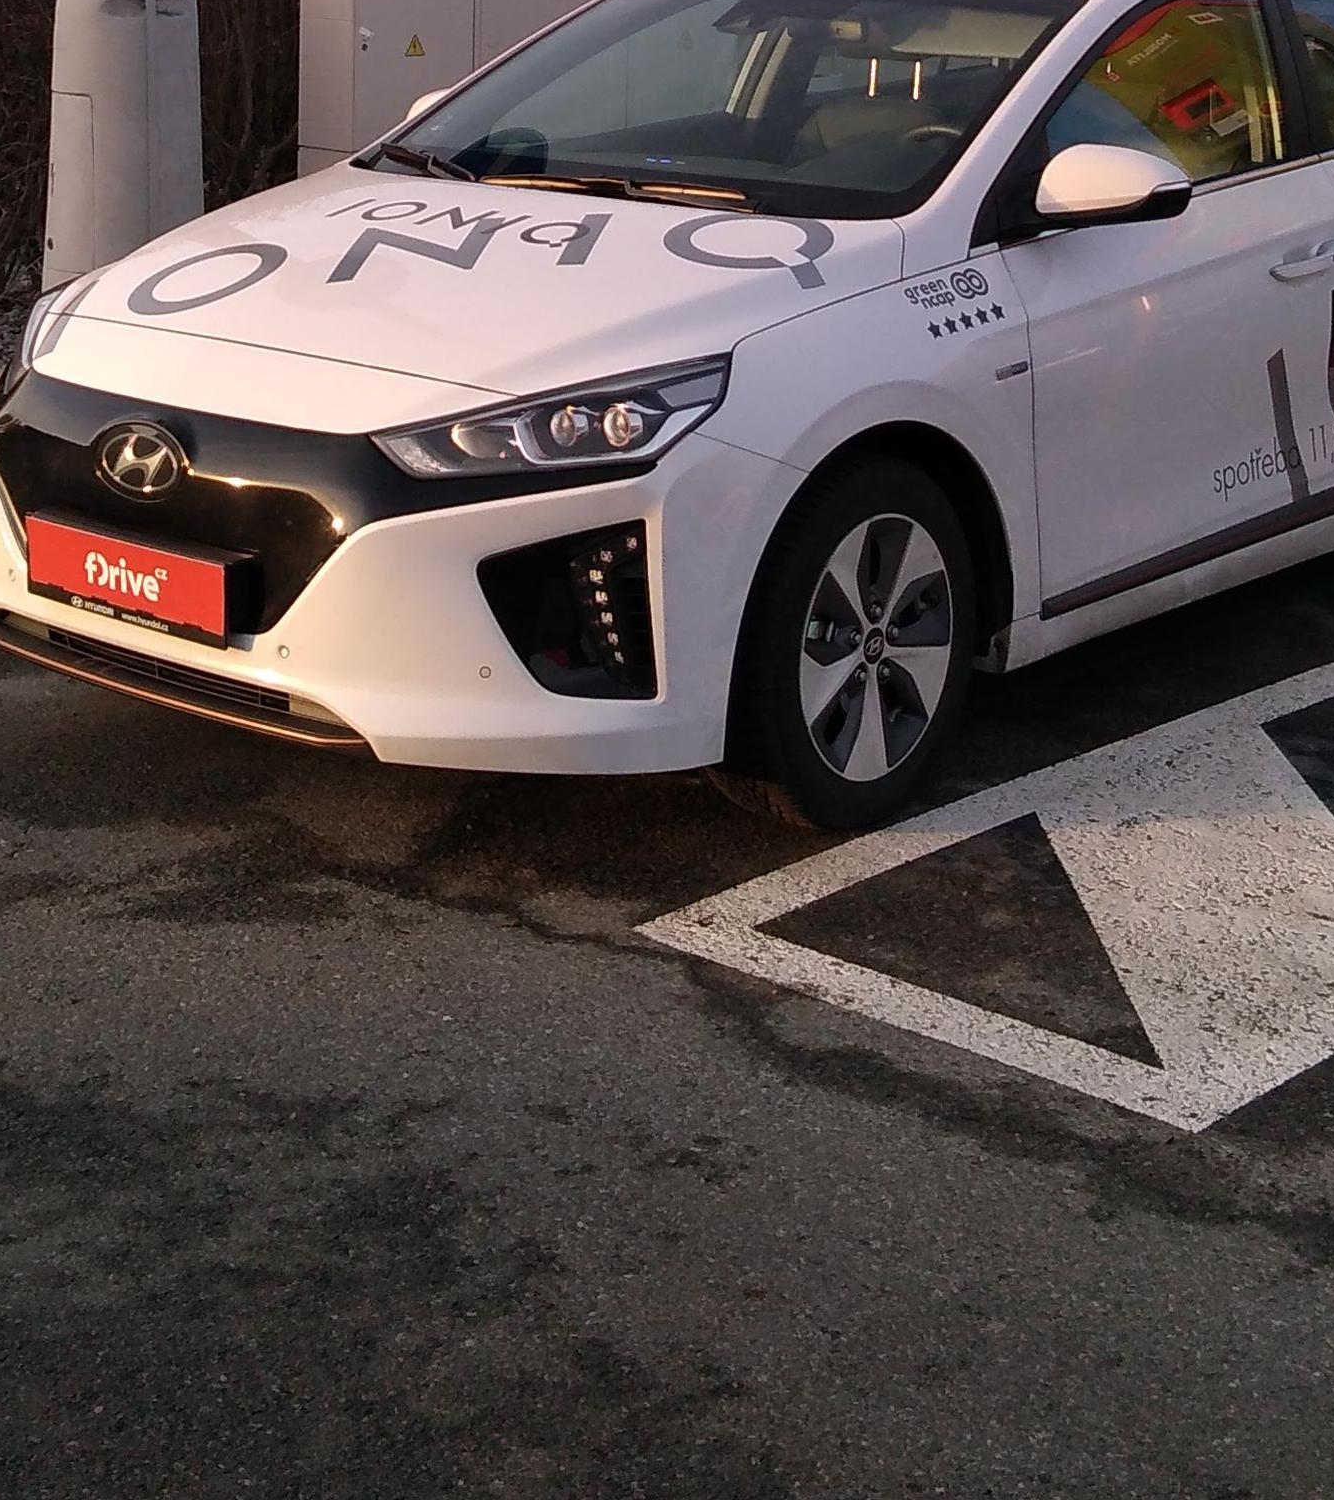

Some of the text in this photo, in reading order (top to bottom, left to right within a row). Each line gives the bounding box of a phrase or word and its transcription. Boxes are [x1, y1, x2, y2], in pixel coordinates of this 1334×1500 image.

[325, 199, 592, 248] IONIQ
[903, 278, 948, 305] green
[919, 290, 956, 309] ncap
[1212, 436, 1301, 502] spotřeba
[84, 600, 115, 617] HYUNDAI
